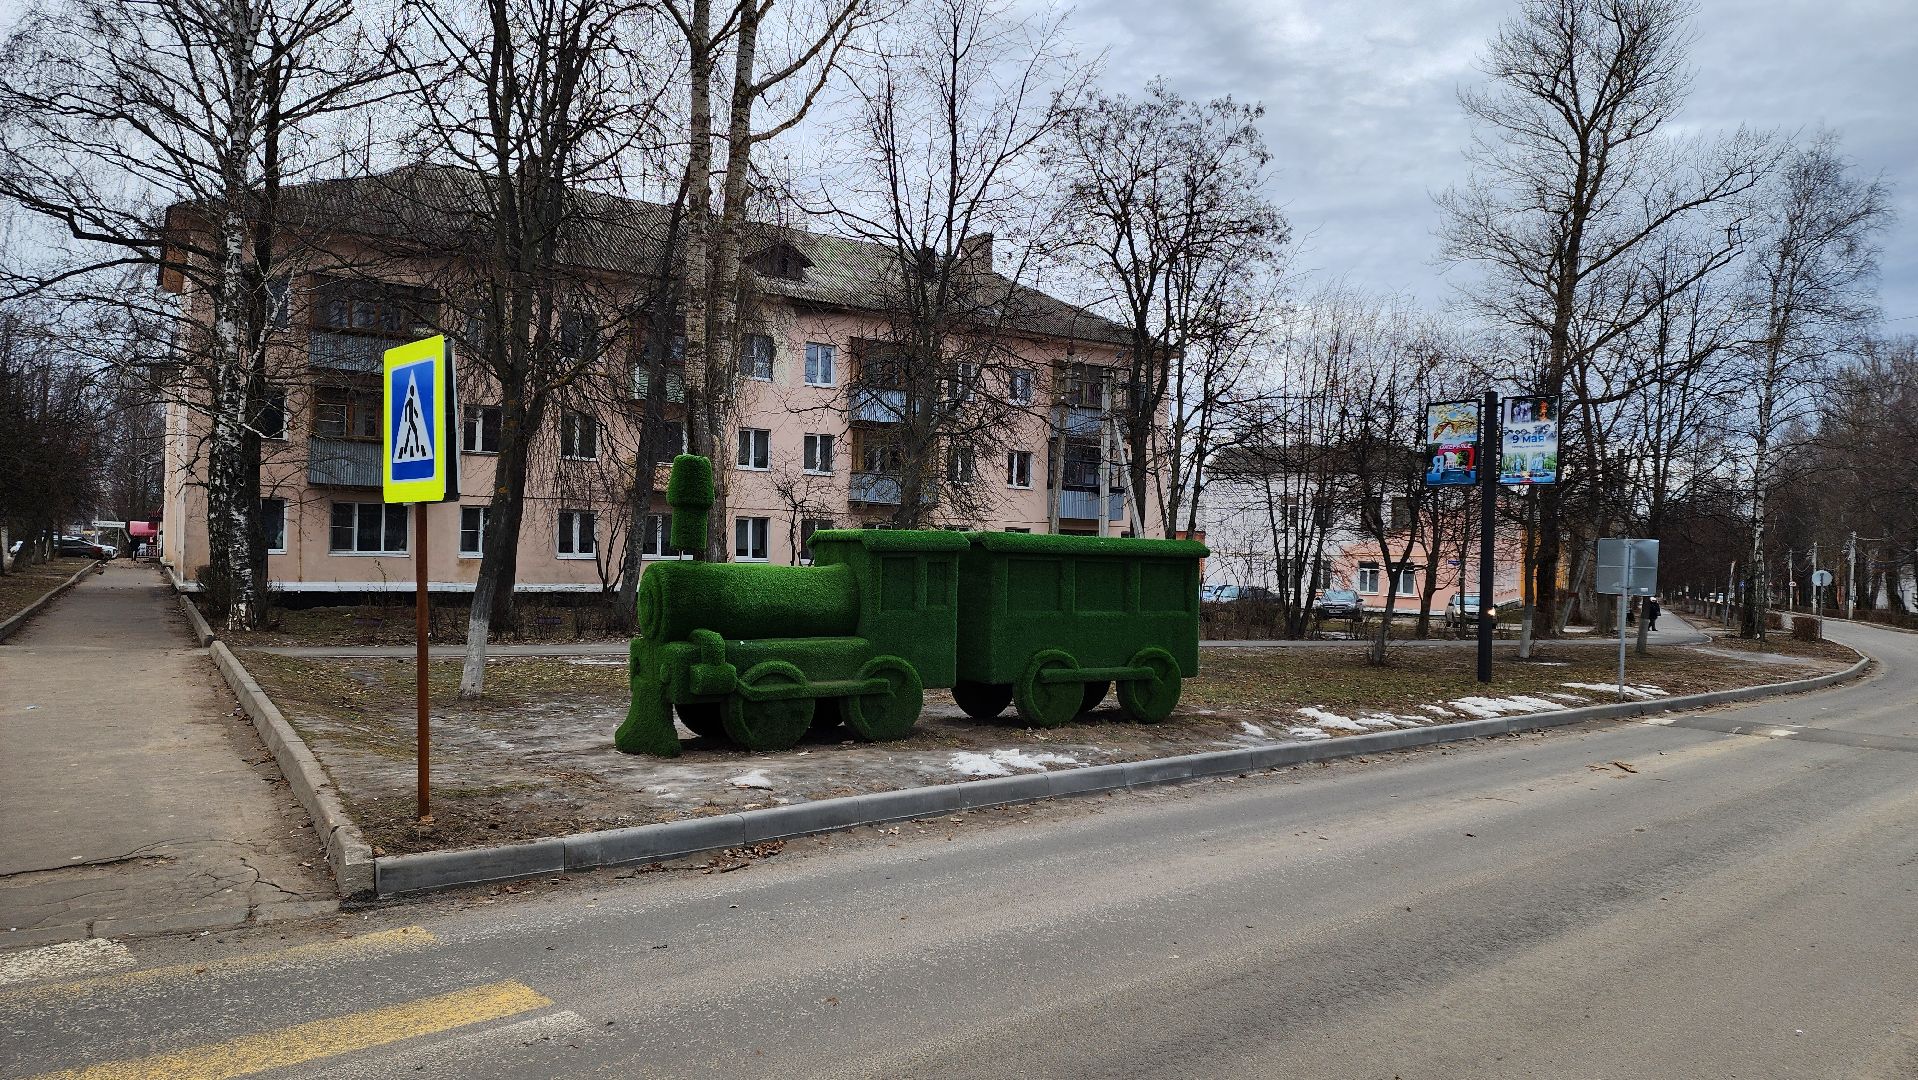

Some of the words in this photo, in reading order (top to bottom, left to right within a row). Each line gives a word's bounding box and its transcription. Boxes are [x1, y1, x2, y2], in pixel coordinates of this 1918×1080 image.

[1512, 435, 1519, 443] 9
[1522, 435, 1545, 443] мая
[1432, 455, 1445, 474] Я
